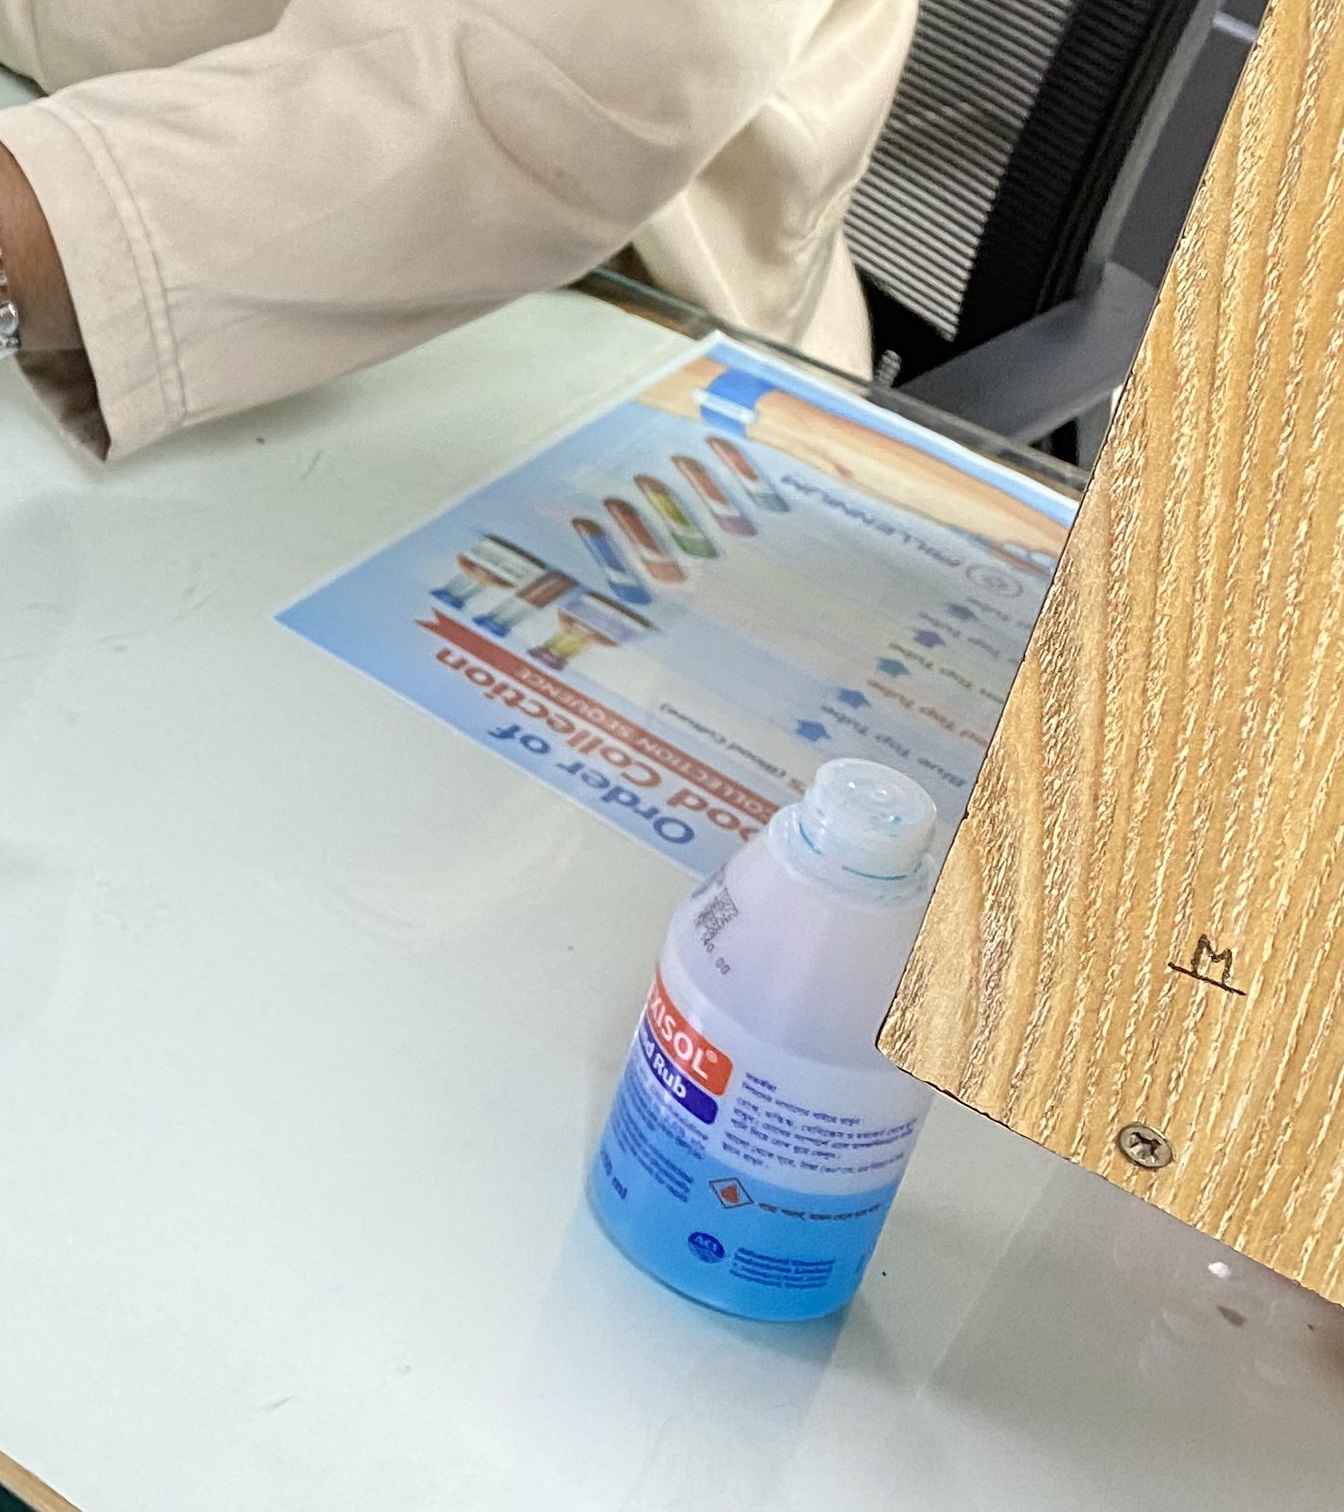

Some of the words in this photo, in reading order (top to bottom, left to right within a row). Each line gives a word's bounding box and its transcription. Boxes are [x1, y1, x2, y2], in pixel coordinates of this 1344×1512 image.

[435, 647, 662, 788] Collection
[516, 667, 633, 737] SEQUENCE
[486, 723, 551, 755] of
[557, 761, 696, 845] Order
[652, 1052, 687, 1099] Rub
